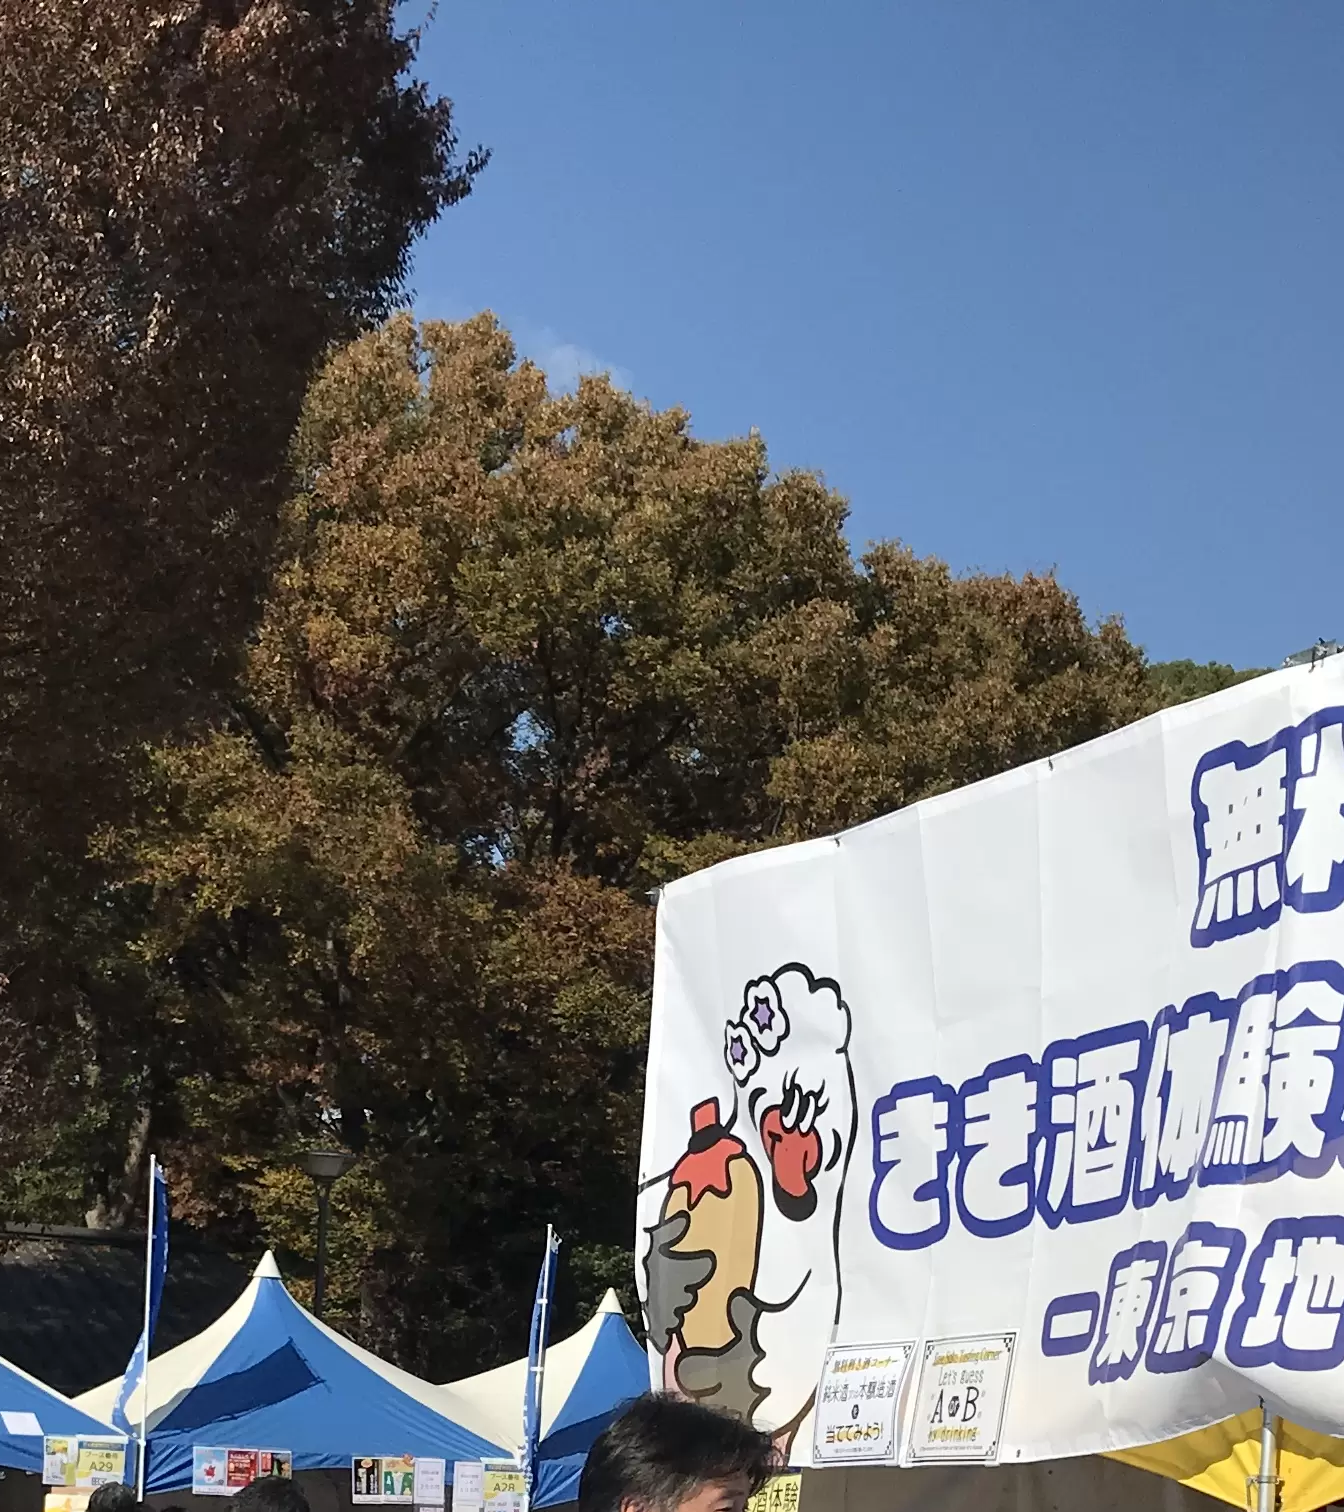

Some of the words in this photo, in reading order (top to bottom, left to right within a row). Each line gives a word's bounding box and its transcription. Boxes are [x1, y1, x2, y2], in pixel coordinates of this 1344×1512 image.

[930, 1389, 943, 1423] A
[961, 1386, 979, 1422] B
[89, 1462, 113, 1472] A29
[493, 1483, 515, 1492] A28
